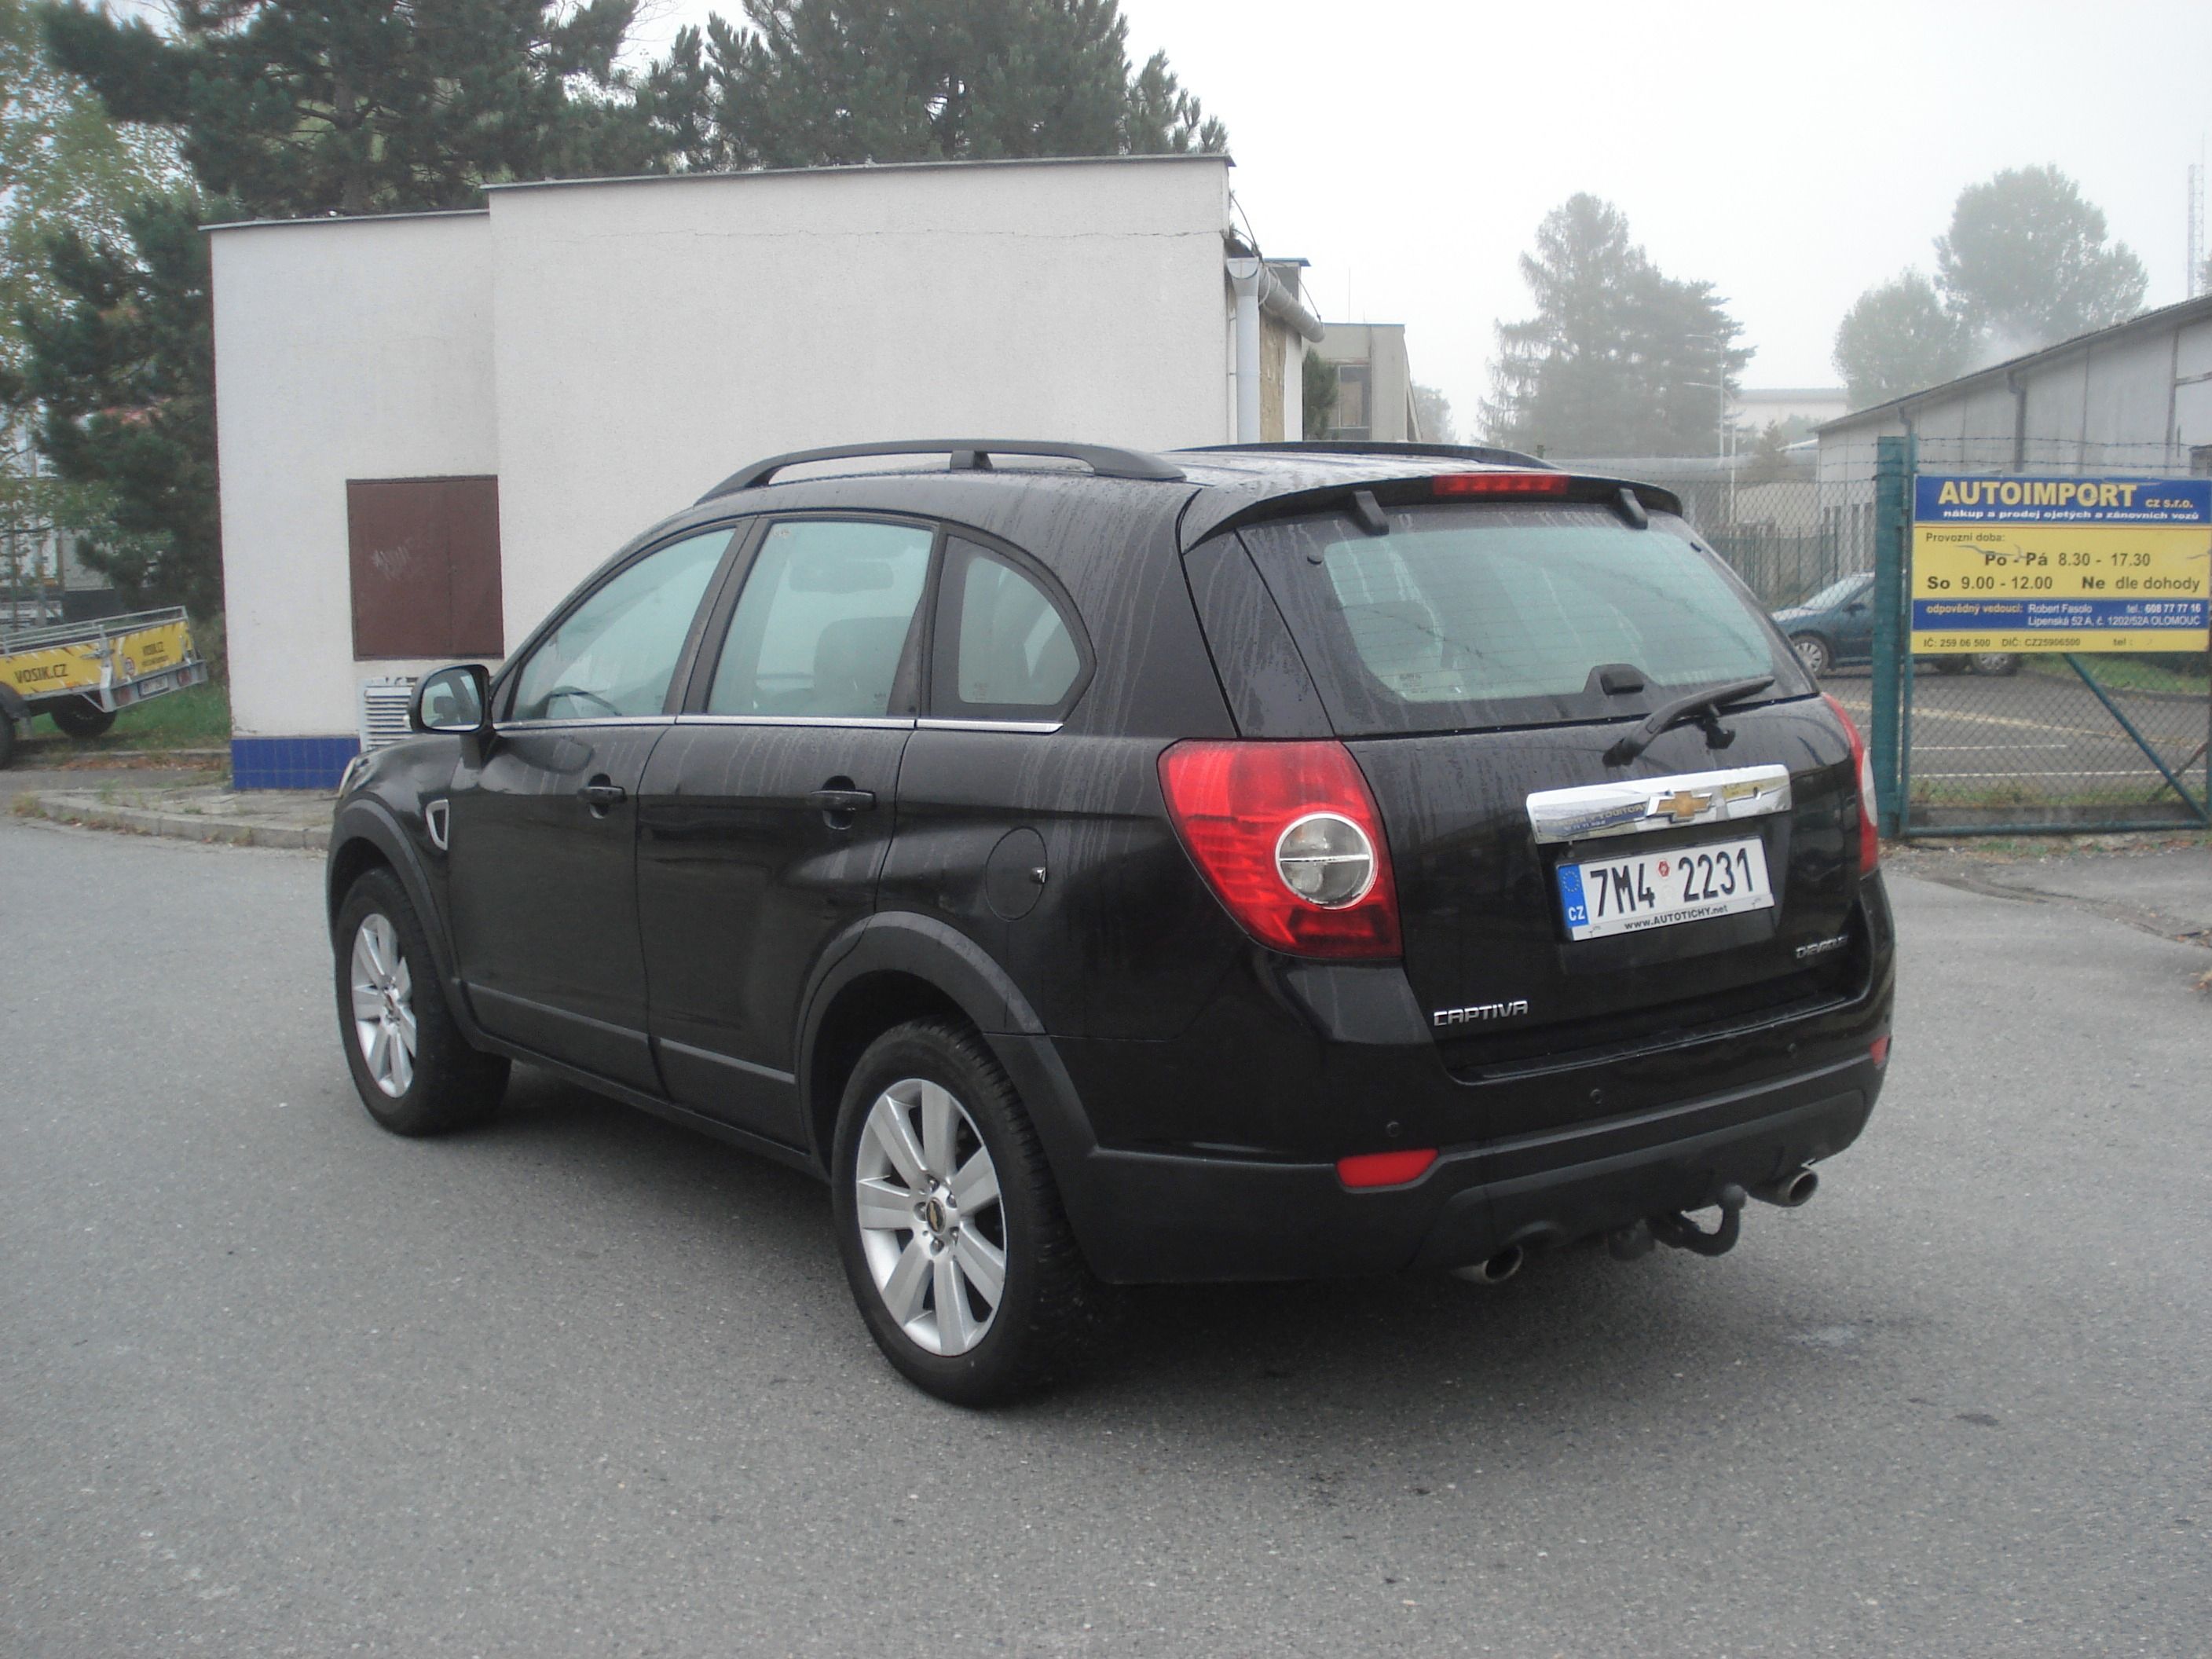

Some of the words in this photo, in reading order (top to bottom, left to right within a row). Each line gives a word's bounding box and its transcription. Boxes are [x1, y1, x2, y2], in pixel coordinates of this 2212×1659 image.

[1938, 481, 2137, 507] AUTOIMPORT
[2163, 499, 2194, 508] s.r.o.
[1943, 510, 1983, 519] nákup
[1999, 511, 2040, 519] prodej
[2044, 511, 2091, 520] ojetých
[2106, 511, 2168, 520] zánovních
[1926, 533, 1972, 542] Provozní
[1976, 533, 2005, 542] doba:
[1984, 551, 2007, 566] Po
[2026, 552, 2048, 566] Pá
[2058, 552, 2090, 566] 8.30
[2111, 553, 2151, 566] 17.30
[1927, 576, 1950, 589] So
[1961, 576, 1994, 589] 9.00
[2012, 577, 2053, 589] 12.00
[2082, 576, 2105, 589] Ne
[2115, 577, 2138, 589] dle
[2144, 577, 2200, 593] dohody
[1926, 603, 1980, 615] odpovědný
[2028, 603, 2060, 613] Robert
[2163, 603, 2175, 613] 77
[2178, 603, 2189, 613] 77
[2027, 616, 2069, 628] Lipenská
[2151, 616, 2201, 626] OLOMOUC
[1974, 639, 1991, 647] 500
[1590, 862, 1655, 917] 7M4
[1678, 848, 1753, 903] 2231
[1568, 906, 1586, 921] CZ
[1624, 905, 1729, 930] www.AUTOTICHY.net
[1434, 1000, 1529, 1027] CAPTIVA
